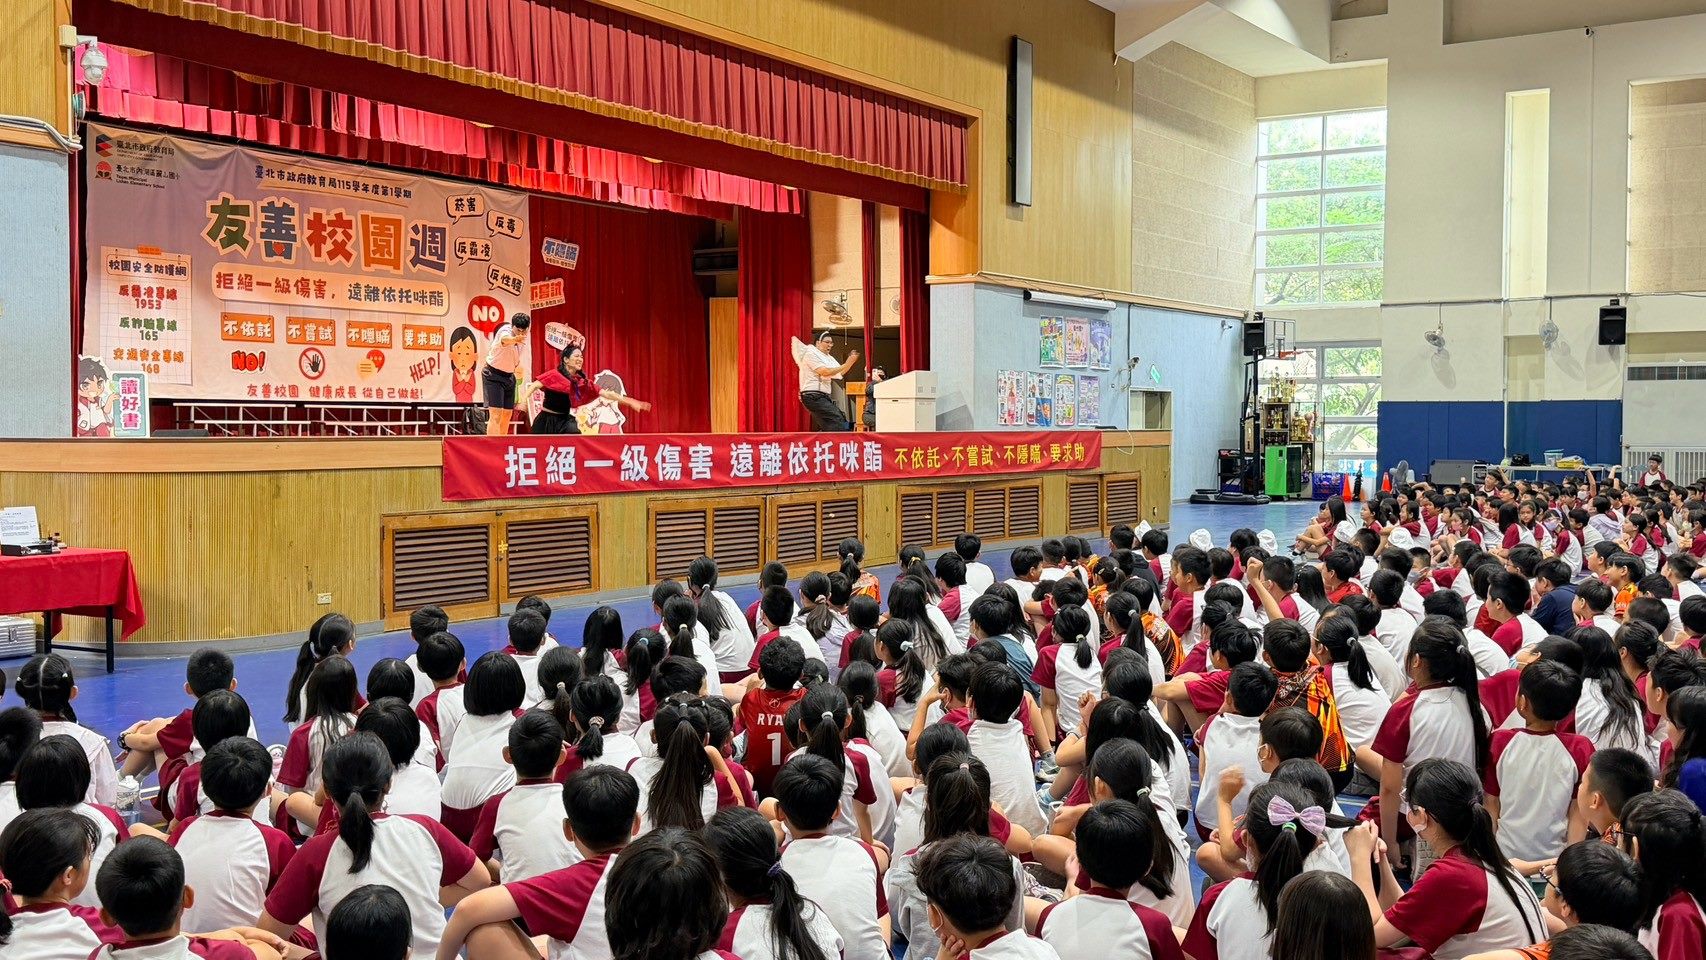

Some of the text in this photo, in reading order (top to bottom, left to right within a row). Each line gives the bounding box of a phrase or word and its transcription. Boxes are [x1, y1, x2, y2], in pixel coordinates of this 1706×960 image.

[255, 165, 412, 199] 臺北市政府教育局115學年度第1學期
[454, 197, 476, 212] 菸害
[495, 216, 516, 233] 反毒
[205, 196, 447, 273] 友善校園週
[457, 241, 491, 257] 反霸凌
[108, 259, 187, 276] 校園安全防護網
[134, 299, 162, 310] 1953
[472, 304, 500, 323] NO
[139, 329, 159, 341] 165
[223, 320, 272, 338] 不依託
[287, 323, 334, 342] 不嘗試
[403, 328, 442, 346] 要求助
[141, 363, 160, 374] 168
[232, 349, 266, 372] NO!
[409, 352, 441, 383] HELP!
[247, 383, 299, 397] 友善校園
[309, 385, 358, 399] 健康成長
[120, 378, 139, 428] 讀好書
[504, 443, 714, 488] 拒絕一級傷害
[730, 440, 883, 479] 遠離依托咪酯
[757, 713, 785, 726] RYA
